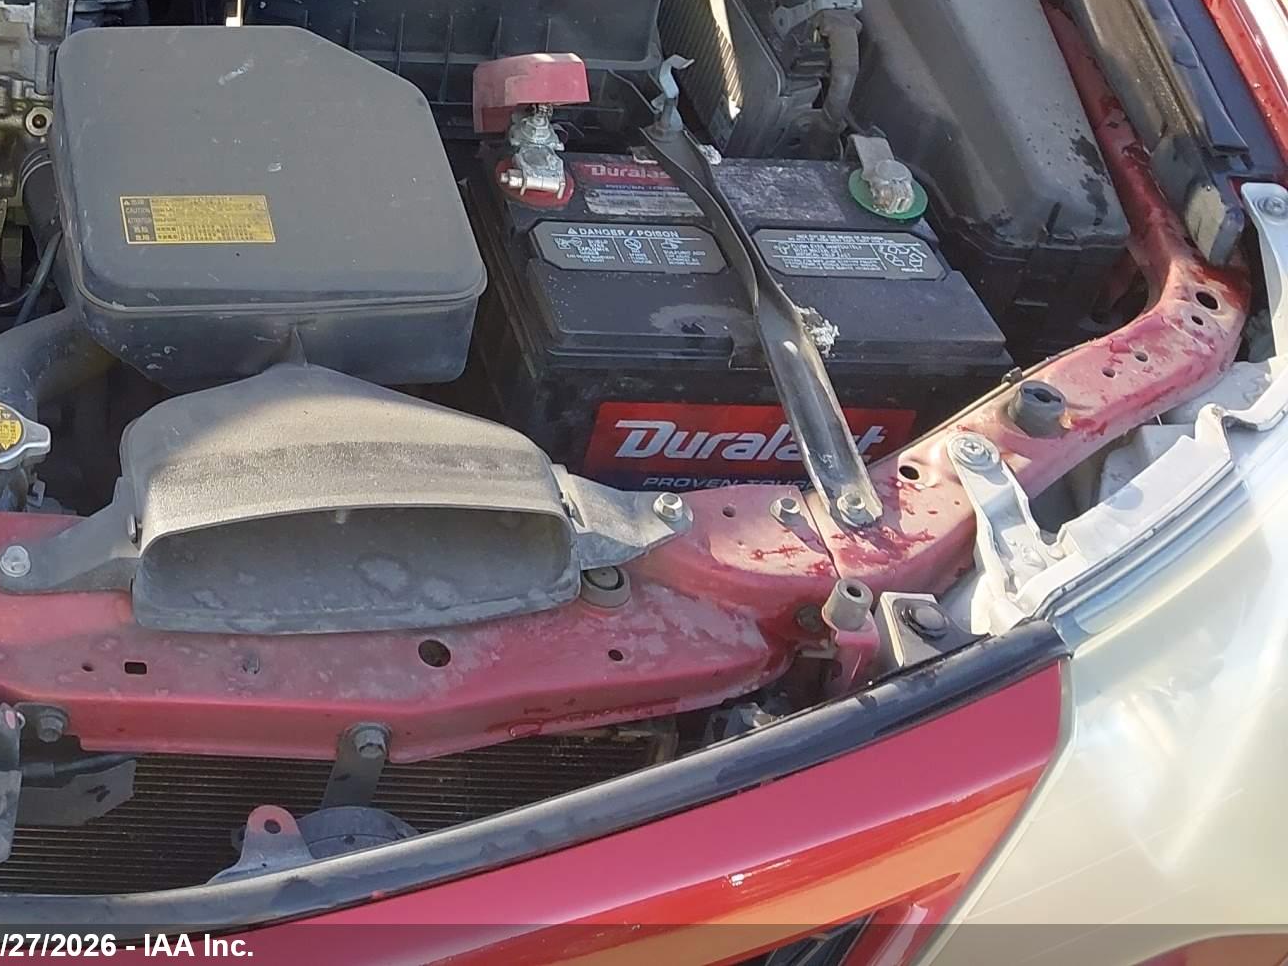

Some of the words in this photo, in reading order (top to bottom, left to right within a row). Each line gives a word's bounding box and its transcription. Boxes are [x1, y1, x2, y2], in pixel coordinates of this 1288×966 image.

[584, 163, 671, 179] Duralas
[579, 228, 626, 237] DANGER
[638, 229, 679, 238] POISON
[615, 419, 888, 463] Duralat
